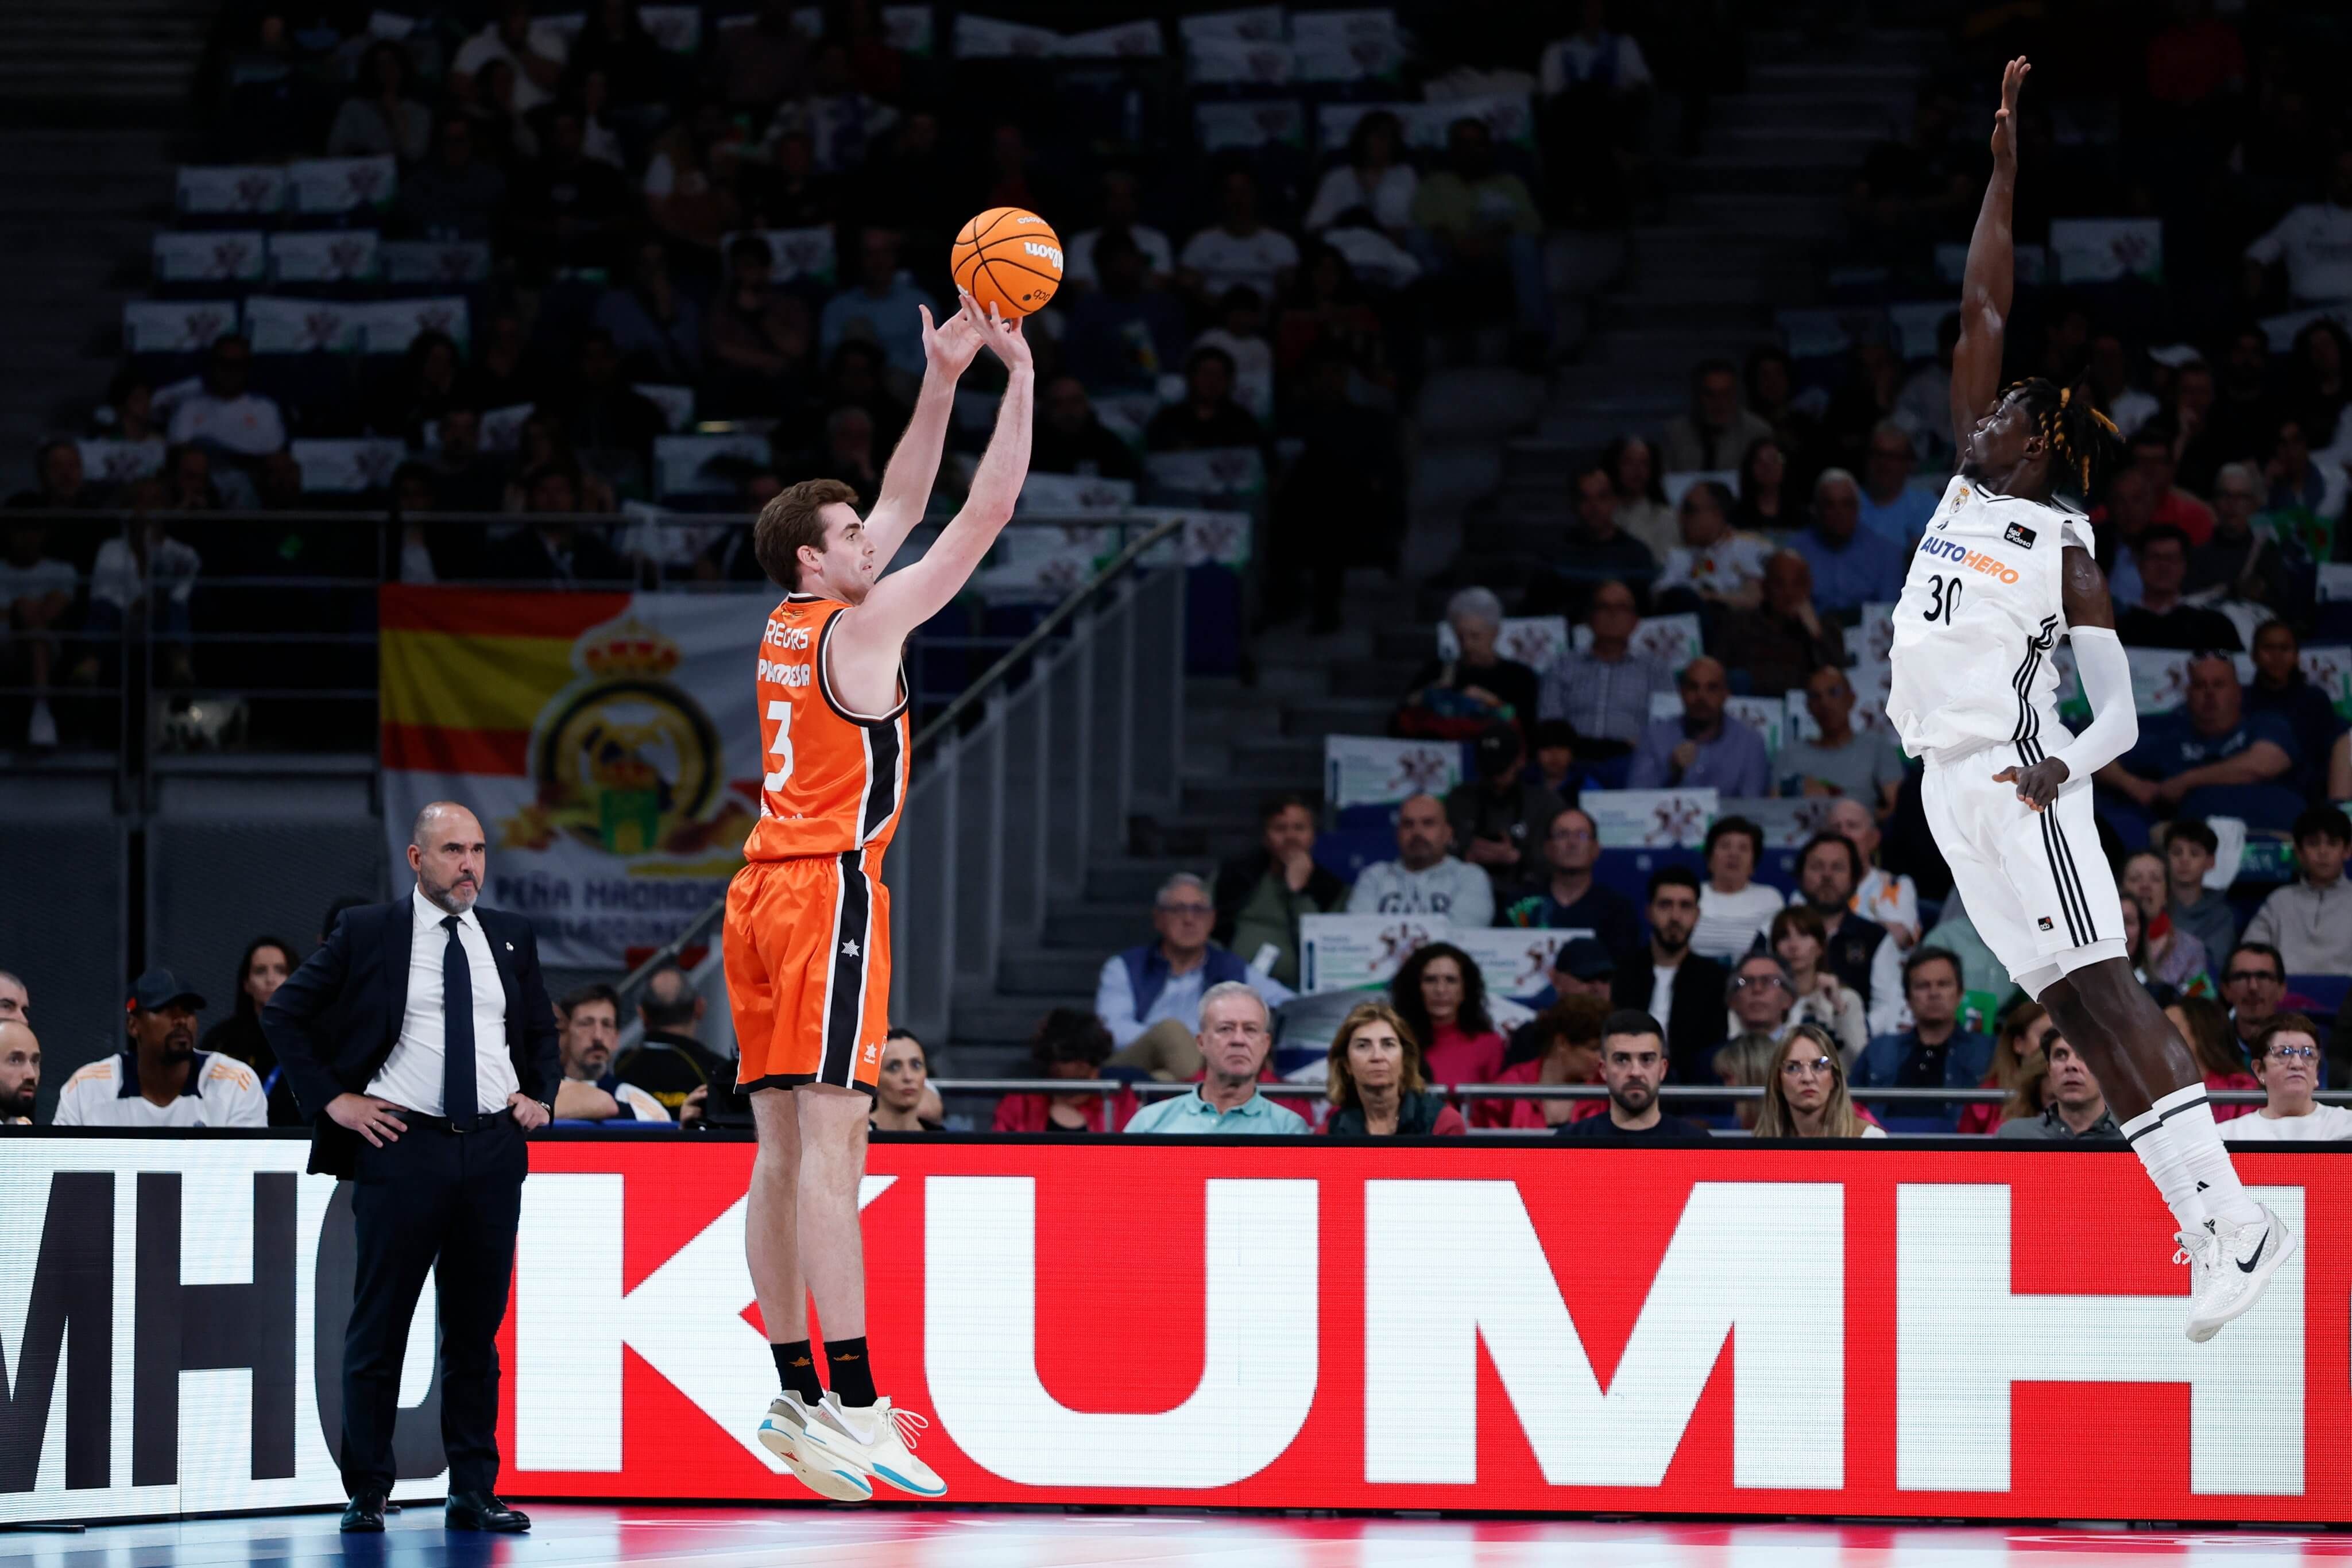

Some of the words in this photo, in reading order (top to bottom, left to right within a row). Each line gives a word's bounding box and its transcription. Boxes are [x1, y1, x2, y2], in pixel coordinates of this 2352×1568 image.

[1033, 289, 1050, 301] acb
[2006, 533, 2032, 548] endesa
[2008, 527, 2020, 536] liga
[1920, 536, 2019, 584] AUTOHERO
[1923, 575, 1962, 626] 30
[757, 659, 810, 687] PAMESA
[764, 700, 794, 792] 3
[515, 1172, 2352, 1497] KUMH
